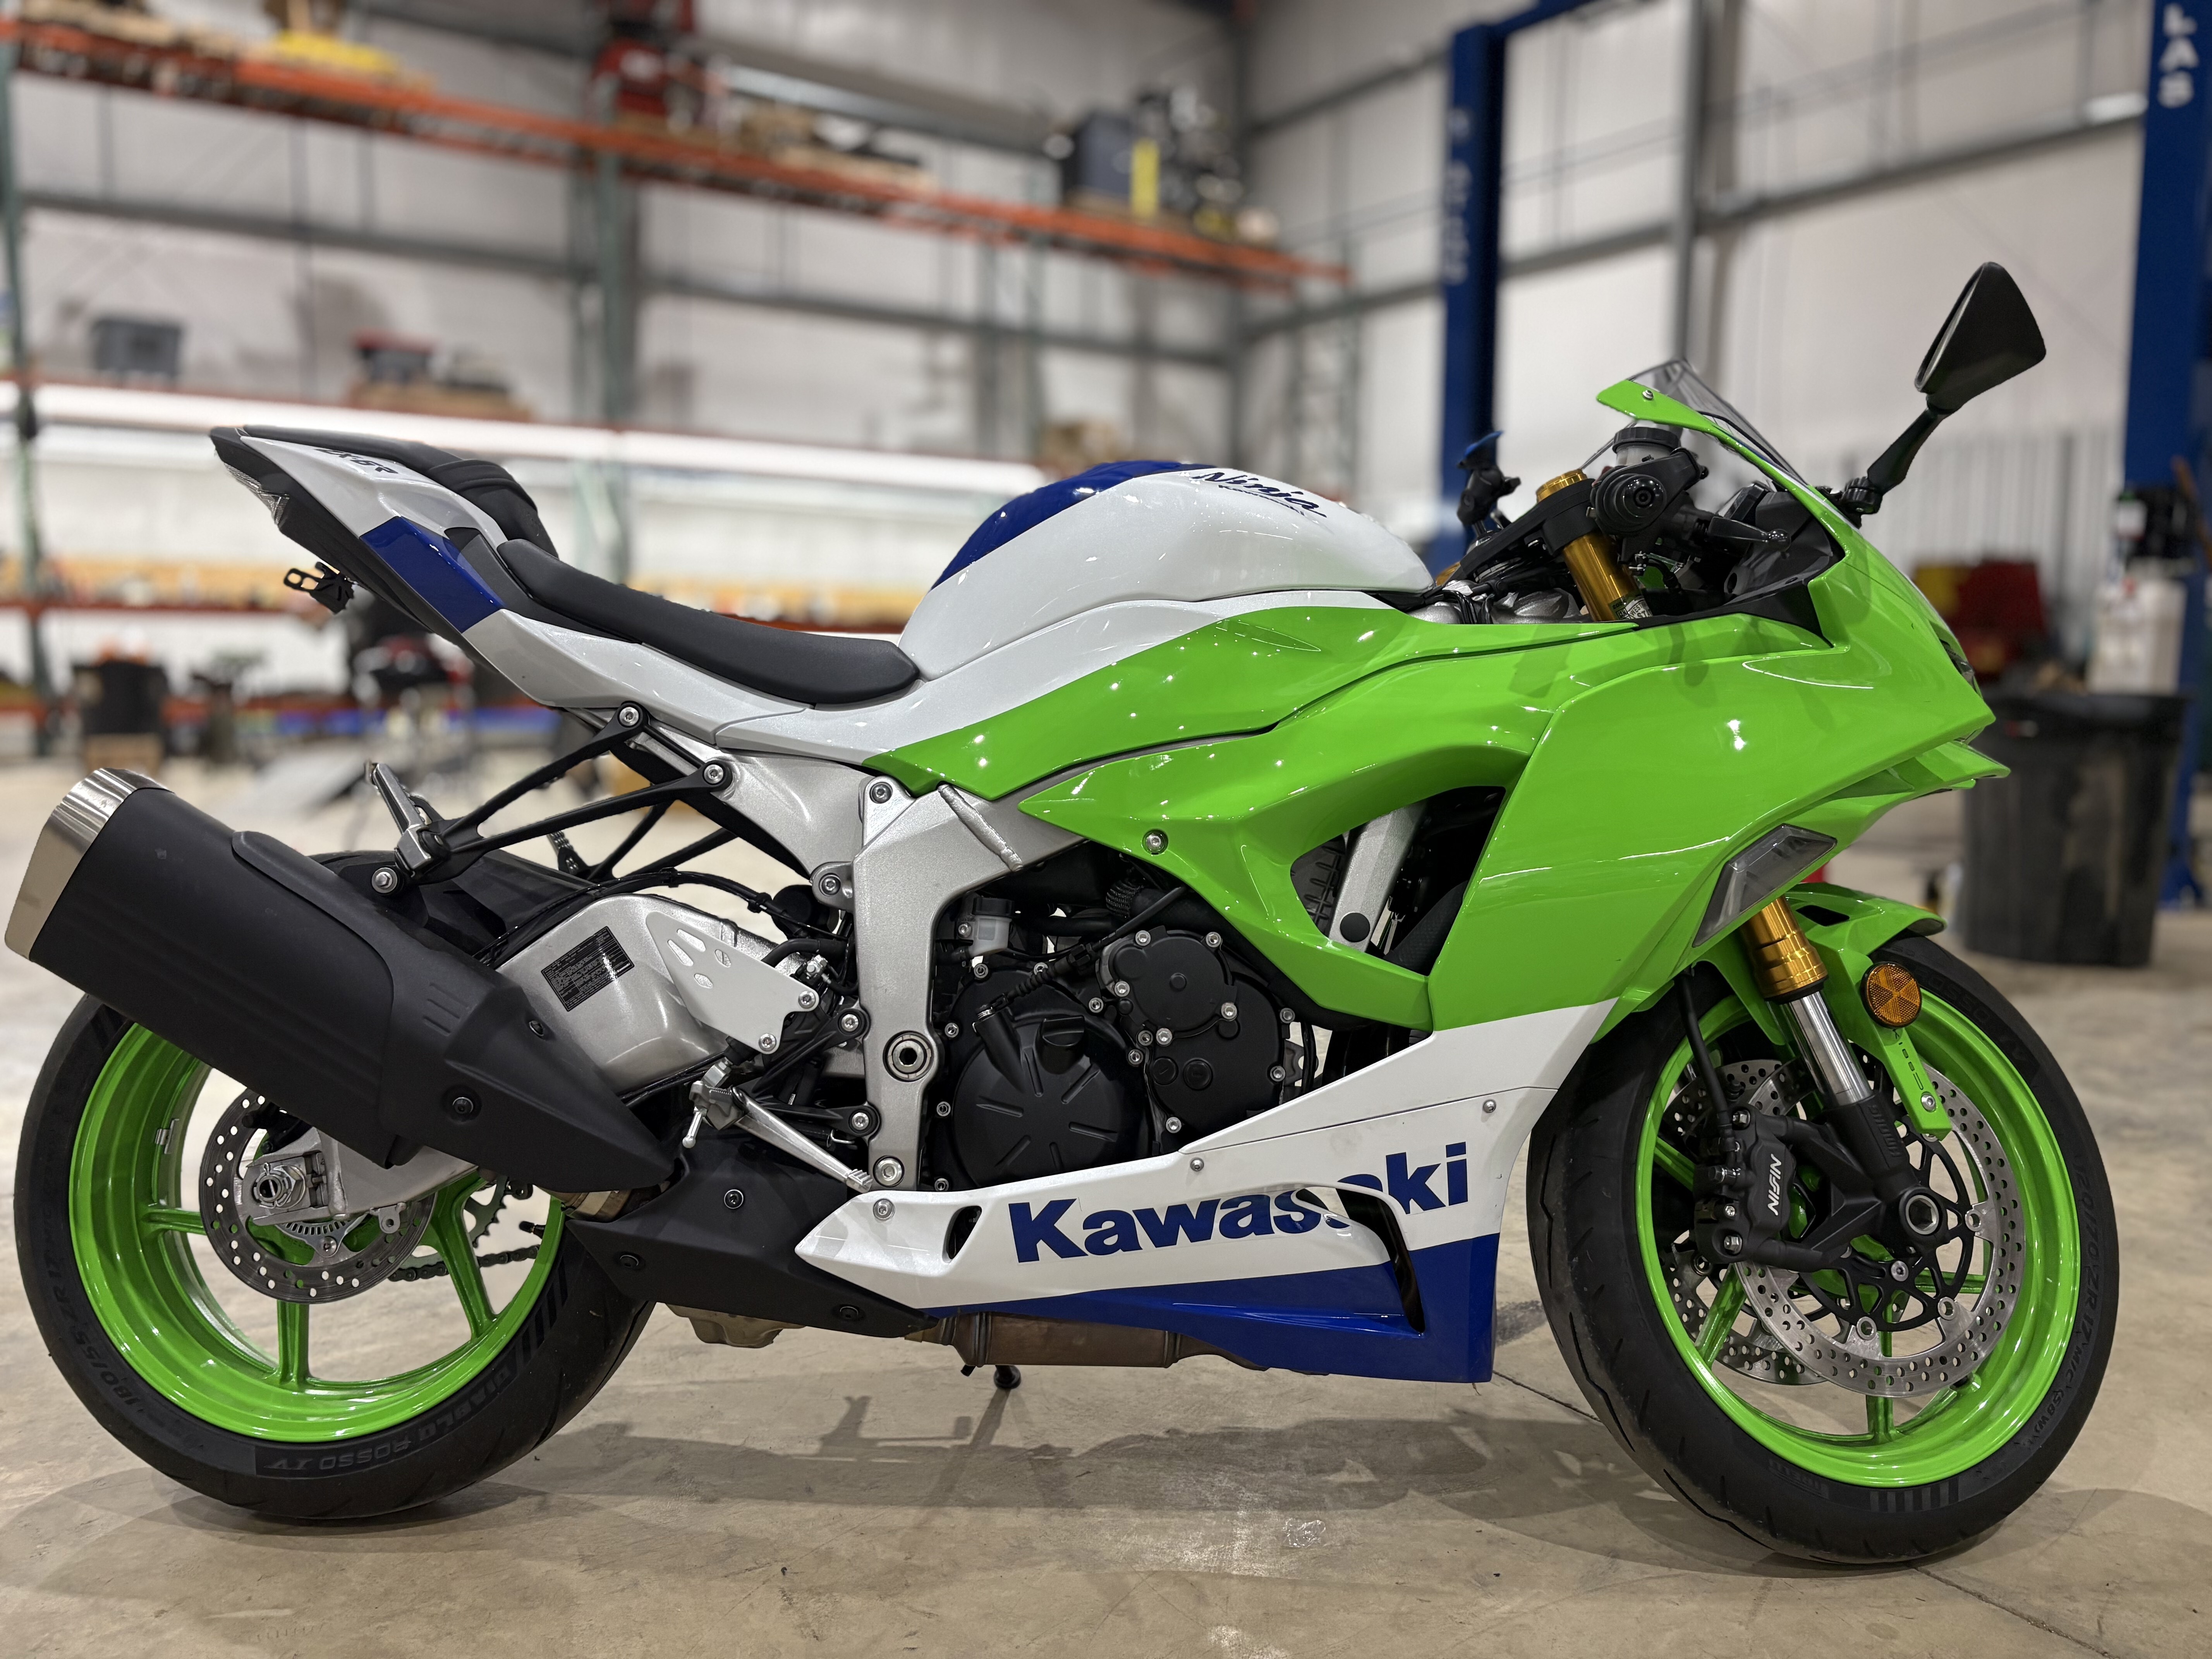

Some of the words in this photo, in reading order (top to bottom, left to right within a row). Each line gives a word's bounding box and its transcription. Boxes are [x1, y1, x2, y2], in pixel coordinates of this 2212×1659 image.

[1190, 472, 1327, 517] Ninja
[1767, 1153, 1781, 1216] NISSIN
[419, 1367, 512, 1440] DIABLO
[321, 1439, 412, 1470] ROSSO
